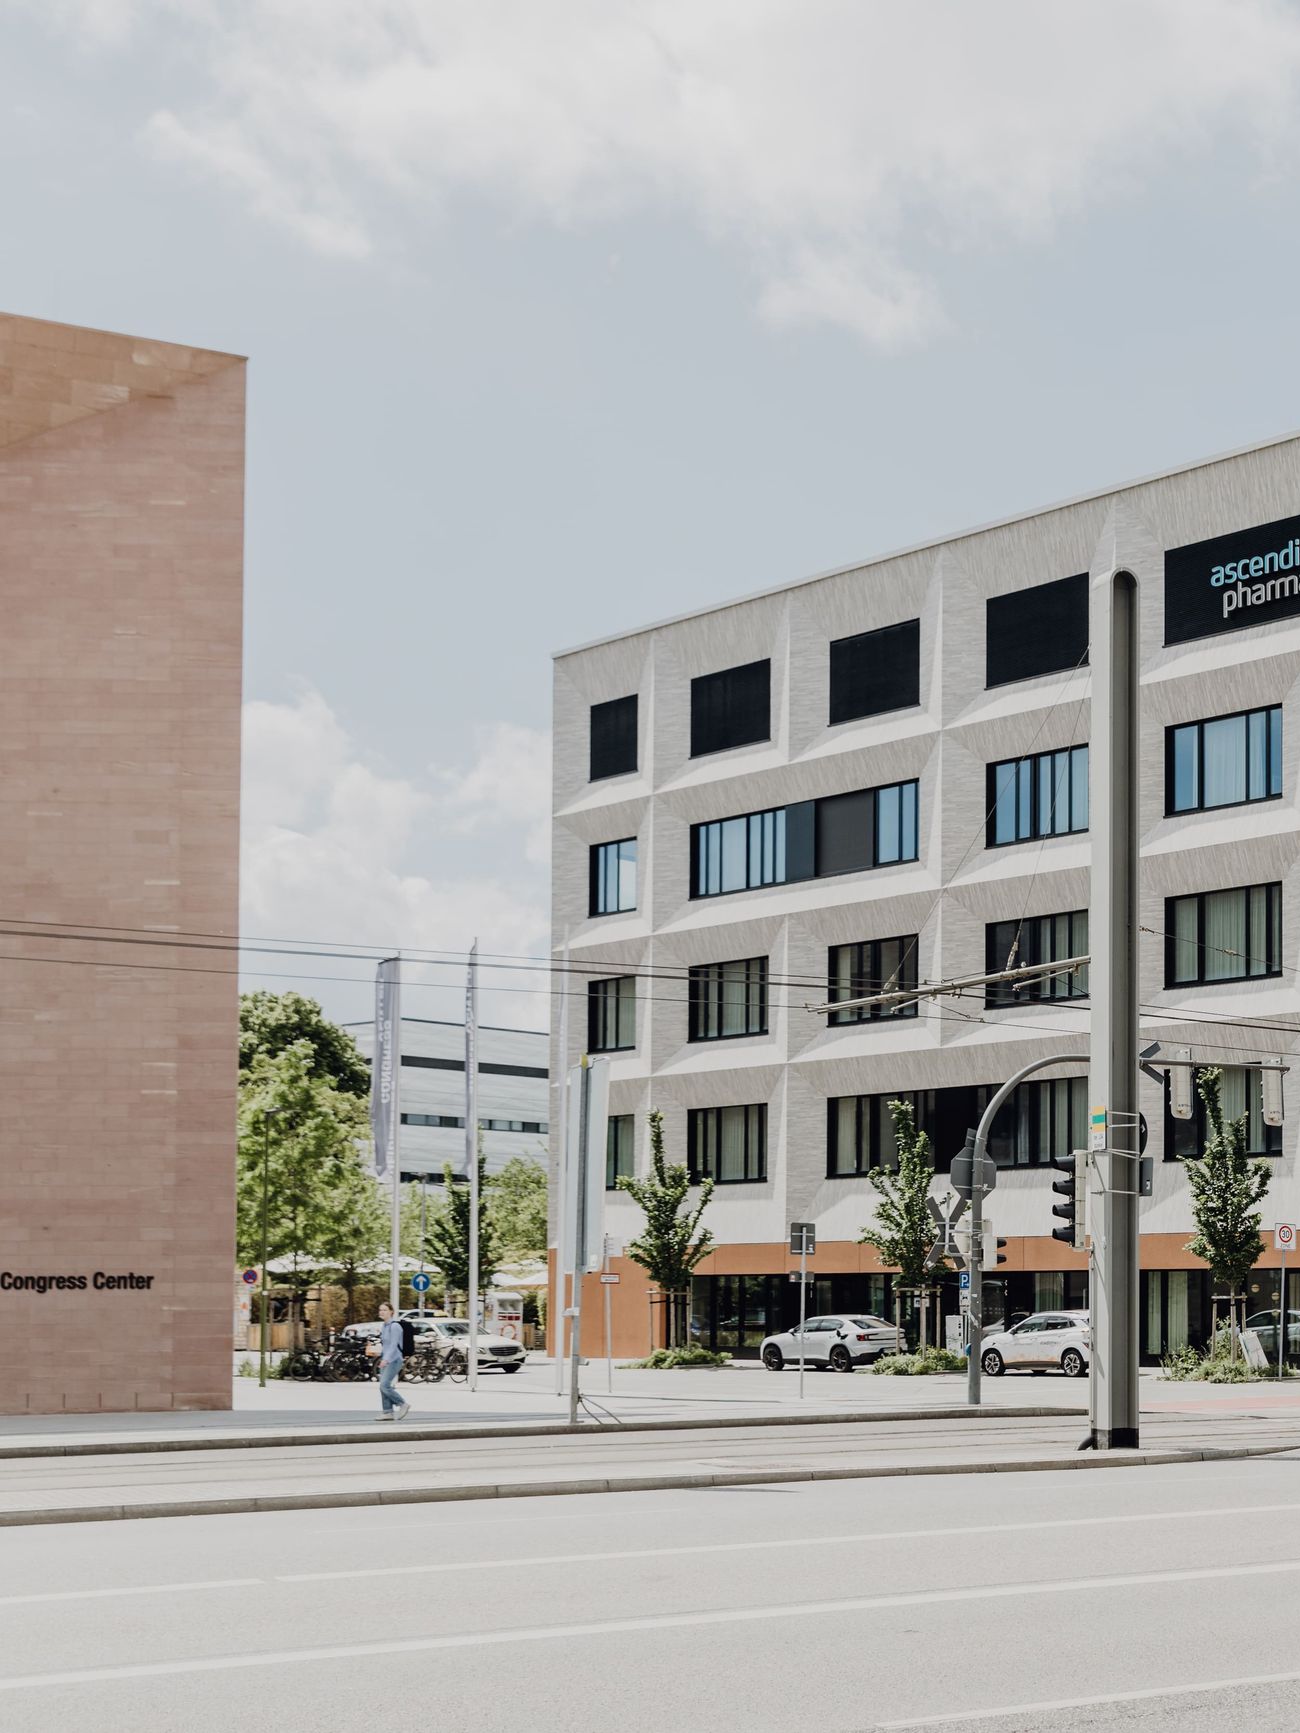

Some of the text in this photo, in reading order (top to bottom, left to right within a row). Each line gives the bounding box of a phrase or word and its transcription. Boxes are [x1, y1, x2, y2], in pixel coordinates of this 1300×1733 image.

[1282, 1230, 1290, 1239] 30
[0, 1271, 154, 1294] Congress Center
[961, 1274, 968, 1287] P
